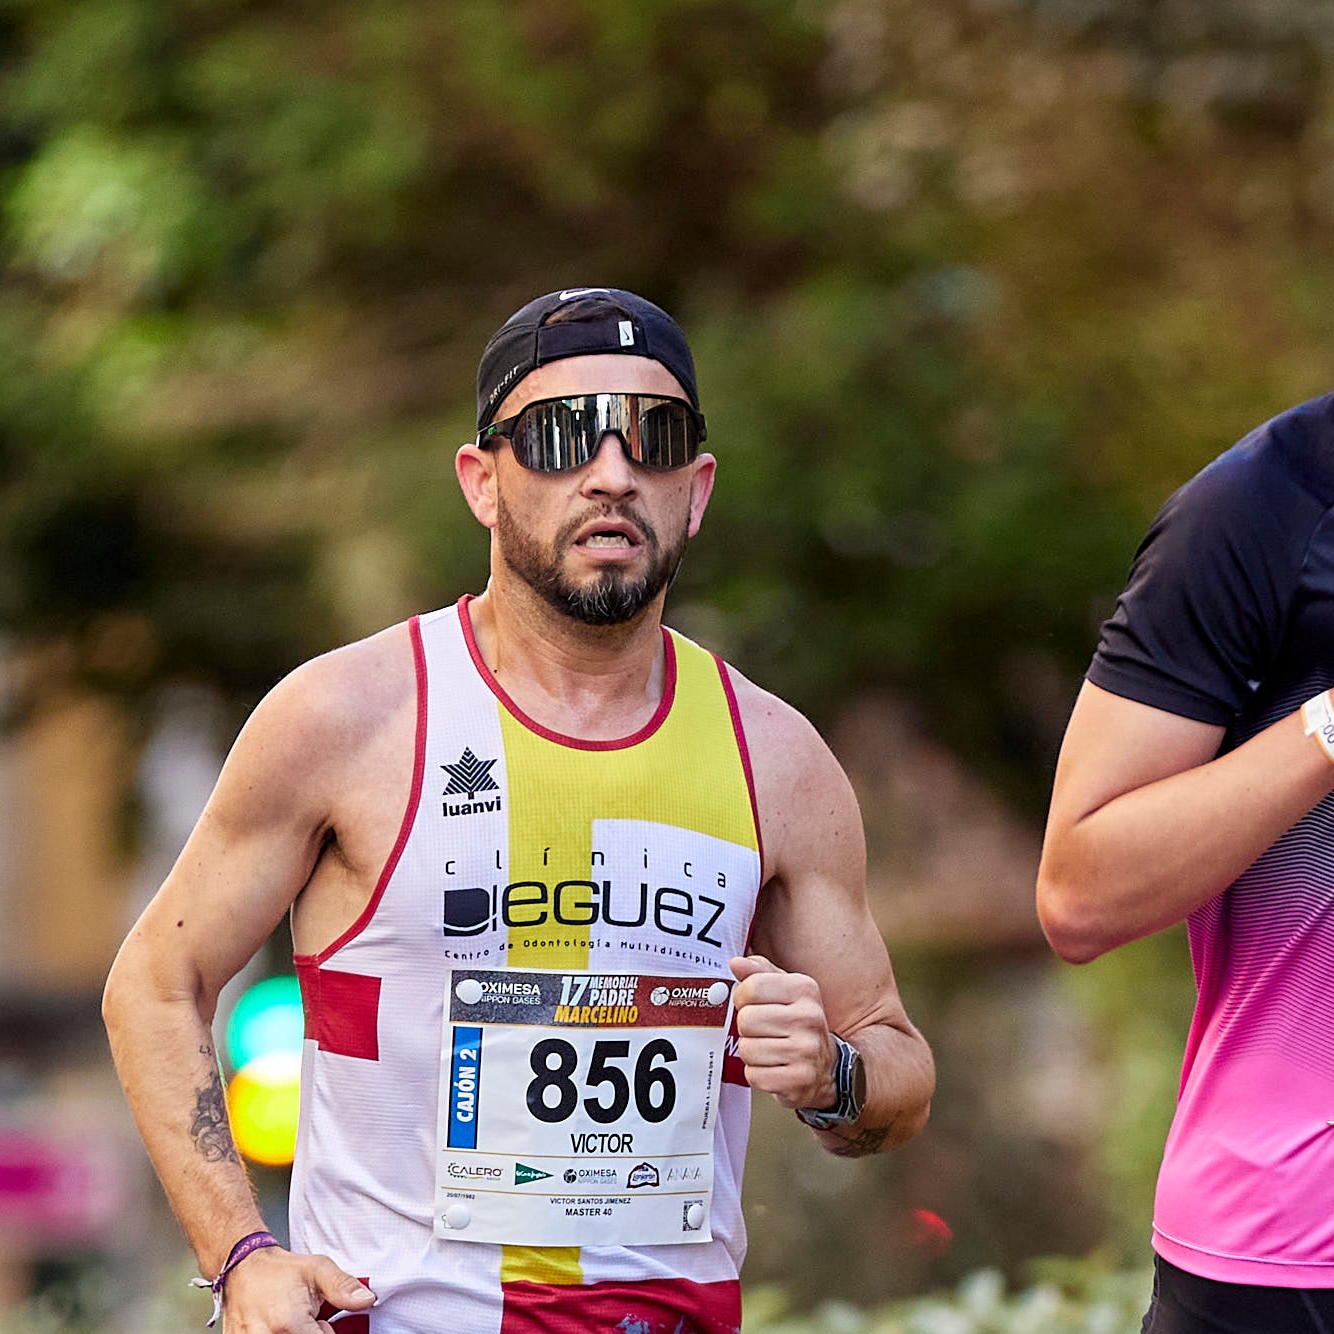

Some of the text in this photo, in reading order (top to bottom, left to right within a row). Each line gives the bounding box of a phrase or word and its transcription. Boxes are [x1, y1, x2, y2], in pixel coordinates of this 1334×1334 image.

[489, 365, 519, 406] DRI-FIT
[442, 796, 502, 817] luanvi
[444, 949, 490, 961] Centro
[499, 942, 514, 951] de
[523, 939, 611, 949] Odontología
[481, 996, 541, 1005] IPPON GASES
[560, 976, 639, 1007] 17 MEMORIAL
[588, 989, 635, 1007] PADRE
[671, 987, 710, 999] OXIME
[668, 1000, 698, 1008] NIPPON
[553, 1005, 639, 1024] MARCELINO
[456, 1048, 477, 1124] CAJÓN 2
[525, 1038, 679, 1124] 856
[570, 1133, 634, 1154] VICTOR
[451, 1165, 503, 1177] CALERO
[578, 1169, 617, 1177] OXIMESA
[666, 1167, 702, 1181] ANAYA
[565, 1208, 612, 1217] MASTER 40
